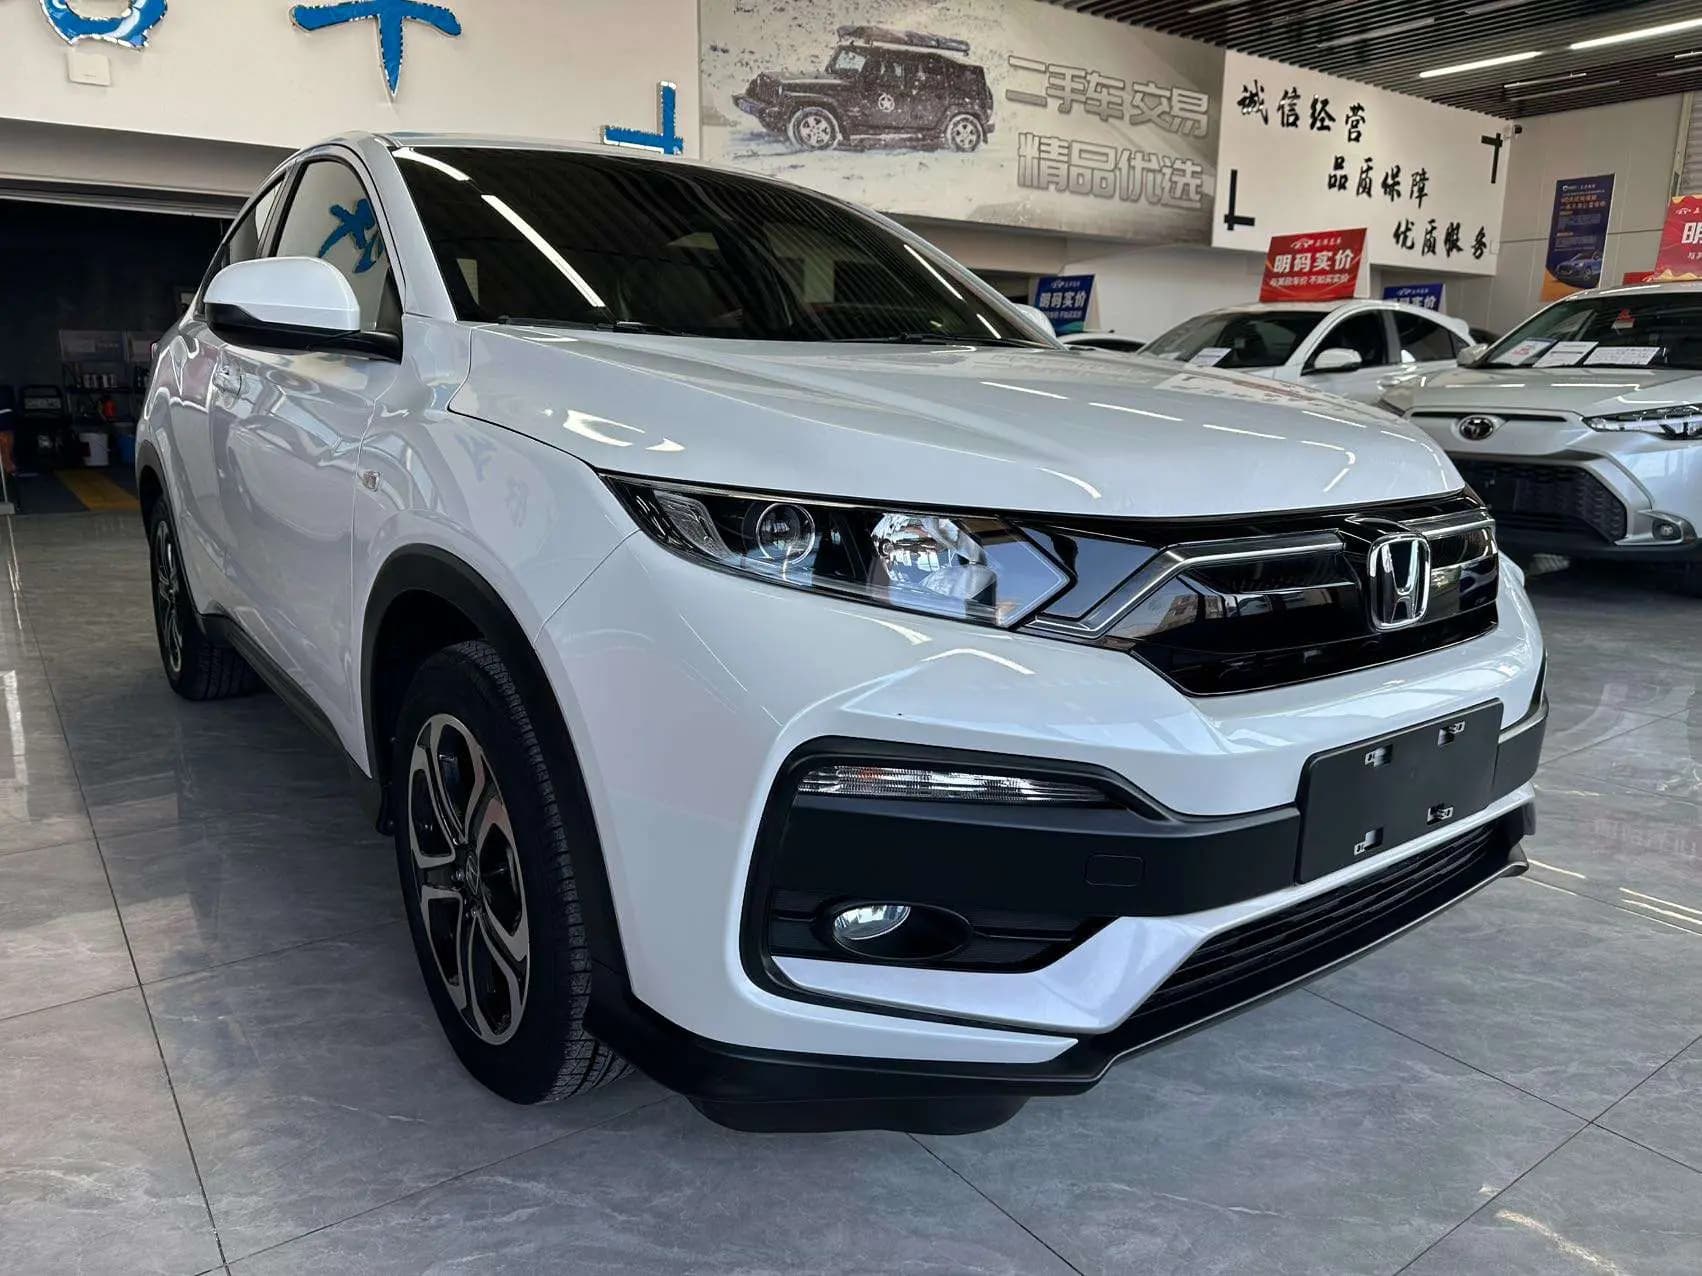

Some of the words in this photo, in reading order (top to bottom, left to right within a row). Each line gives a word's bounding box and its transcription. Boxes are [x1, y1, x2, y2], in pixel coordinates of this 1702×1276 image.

[1005, 55, 1209, 139] 二手车交易
[1237, 80, 1366, 142] 诚信经营
[1017, 132, 1203, 209] 精品优选
[1328, 155, 1429, 208] 品质保障
[1273, 249, 1354, 273] 明码实价
[1393, 217, 1487, 259] 优质服务
